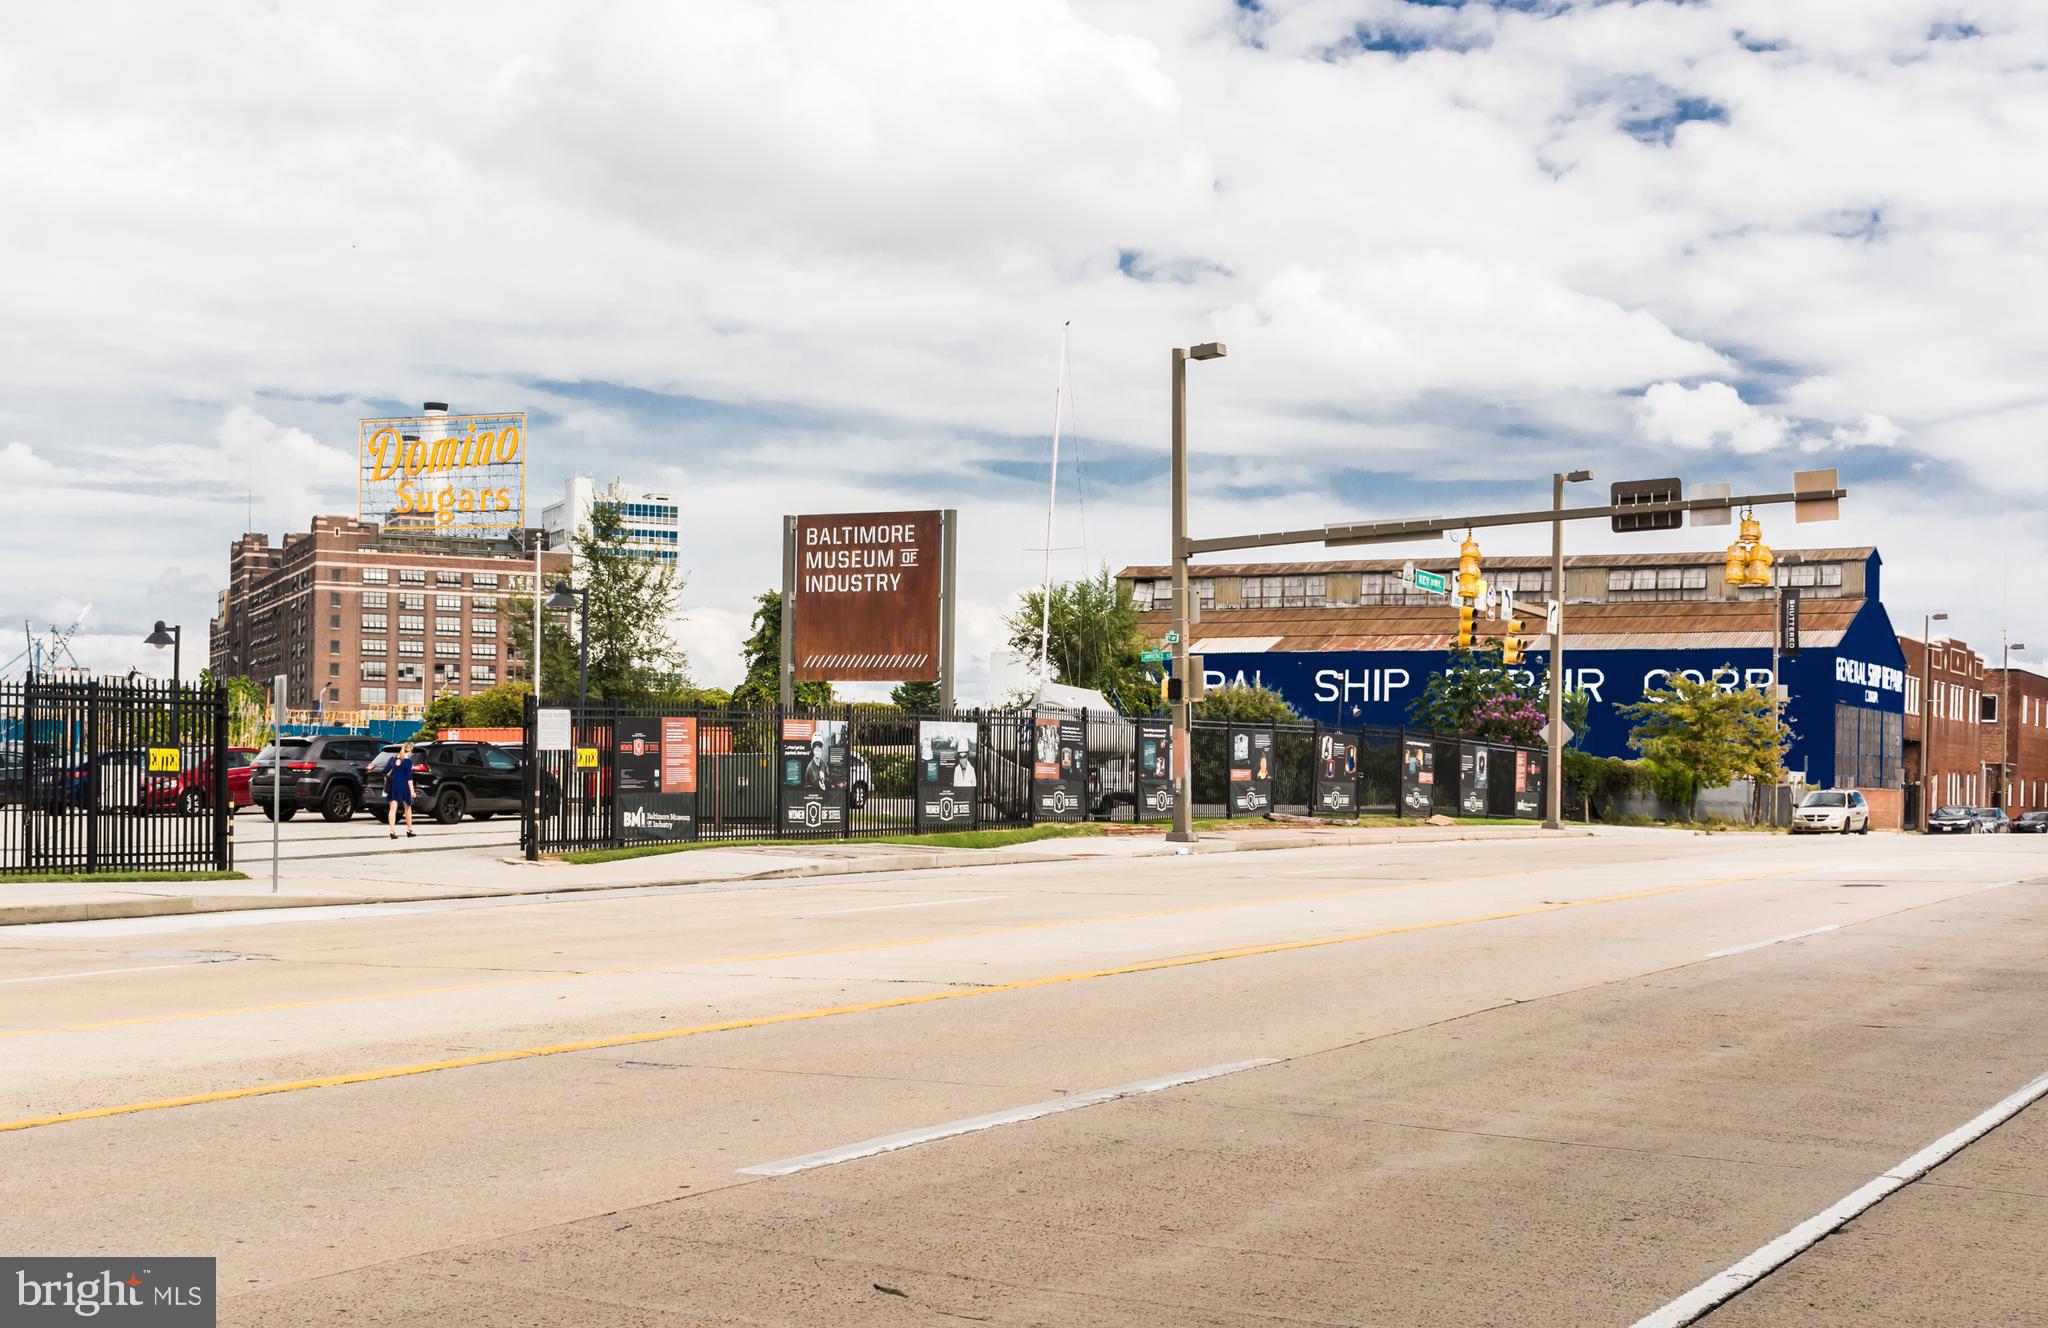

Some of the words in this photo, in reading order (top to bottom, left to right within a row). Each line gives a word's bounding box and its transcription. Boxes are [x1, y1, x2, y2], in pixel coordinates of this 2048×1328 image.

[367, 423, 520, 482] Domino
[396, 481, 511, 524] Sugars
[806, 524, 916, 546] BALTIMORE
[806, 549, 894, 569] MUSEUM
[901, 551, 918, 564] OF
[805, 573, 902, 593] INDUSTRY
[1418, 574, 1430, 587] KEY
[1788, 599, 1796, 649] SHUTTERED
[1836, 656, 1867, 686] GENERAL
[1314, 668, 1410, 702] SHIP
[149, 748, 180, 771] ENTER
[623, 806, 645, 827] BMI
[788, 809, 805, 820] WOMEN
[821, 809, 828, 820] OF
[828, 809, 841, 820] STEEL
